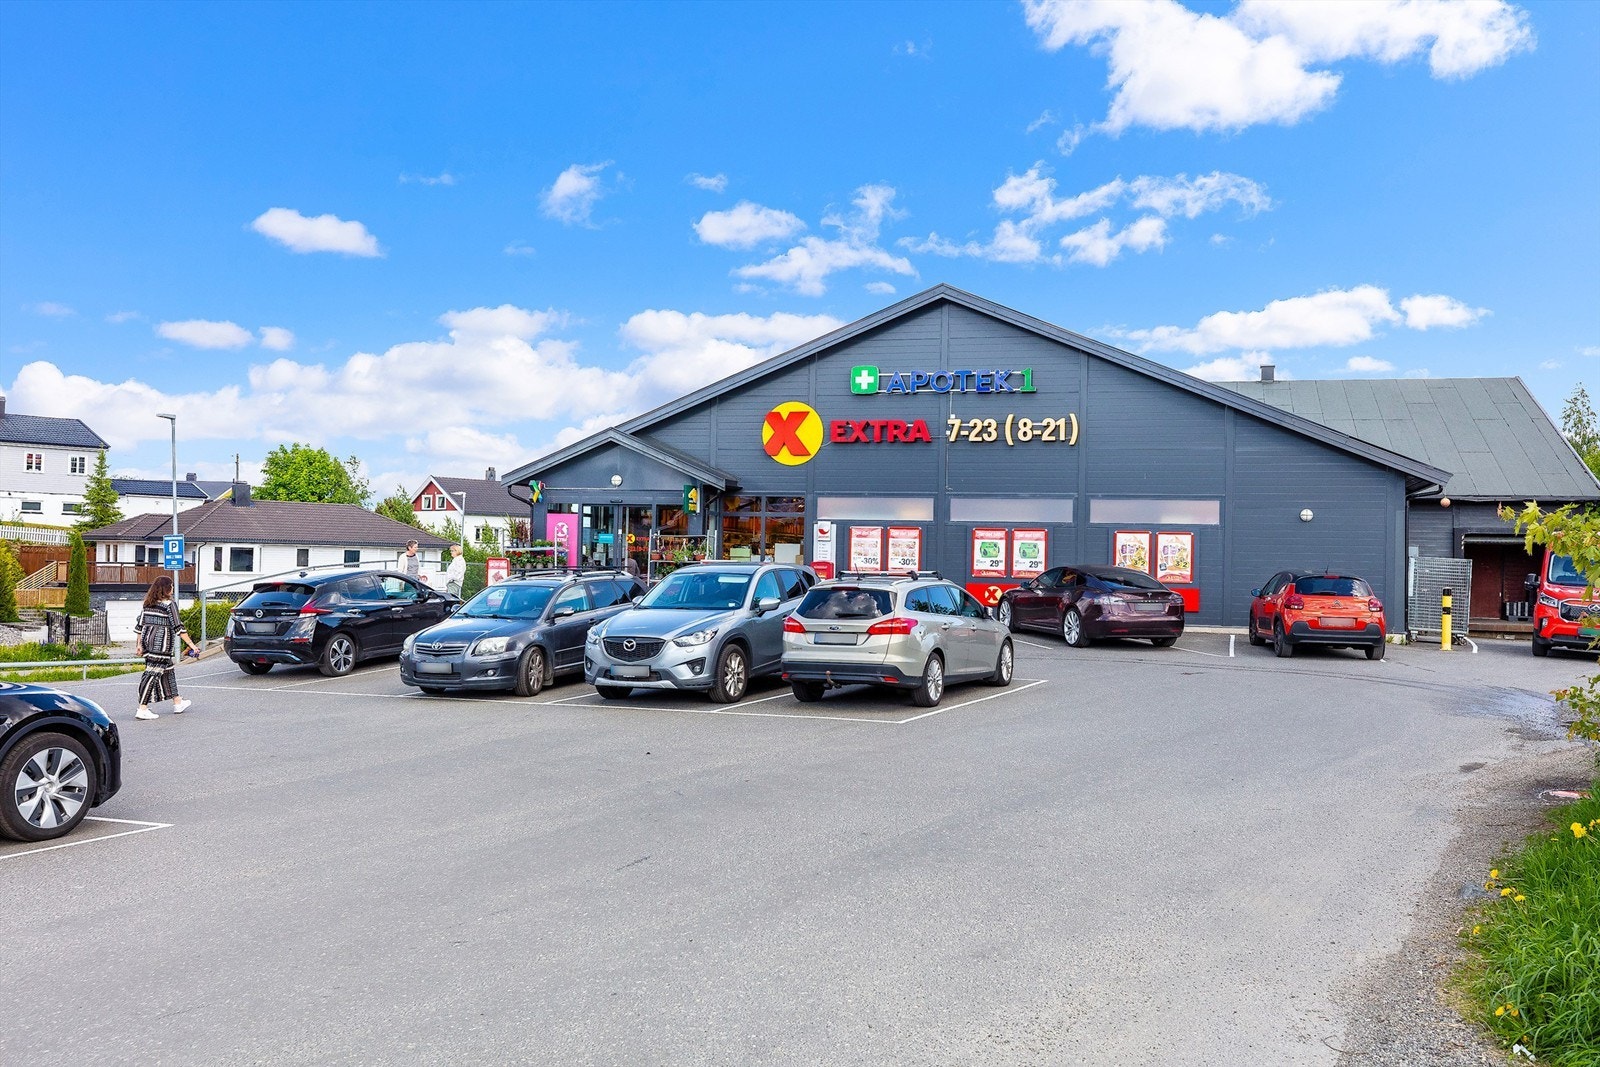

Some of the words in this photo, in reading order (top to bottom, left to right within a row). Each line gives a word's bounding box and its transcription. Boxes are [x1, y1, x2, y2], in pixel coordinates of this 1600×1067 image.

[885, 369, 1015, 394] APOTEK
[763, 411, 812, 457] X
[830, 418, 932, 443] EXTRA
[947, 418, 998, 443] 7-23
[1004, 413, 1079, 446] (8-21)
[861, 557, 879, 565] -30%
[898, 558, 917, 566] -30%
